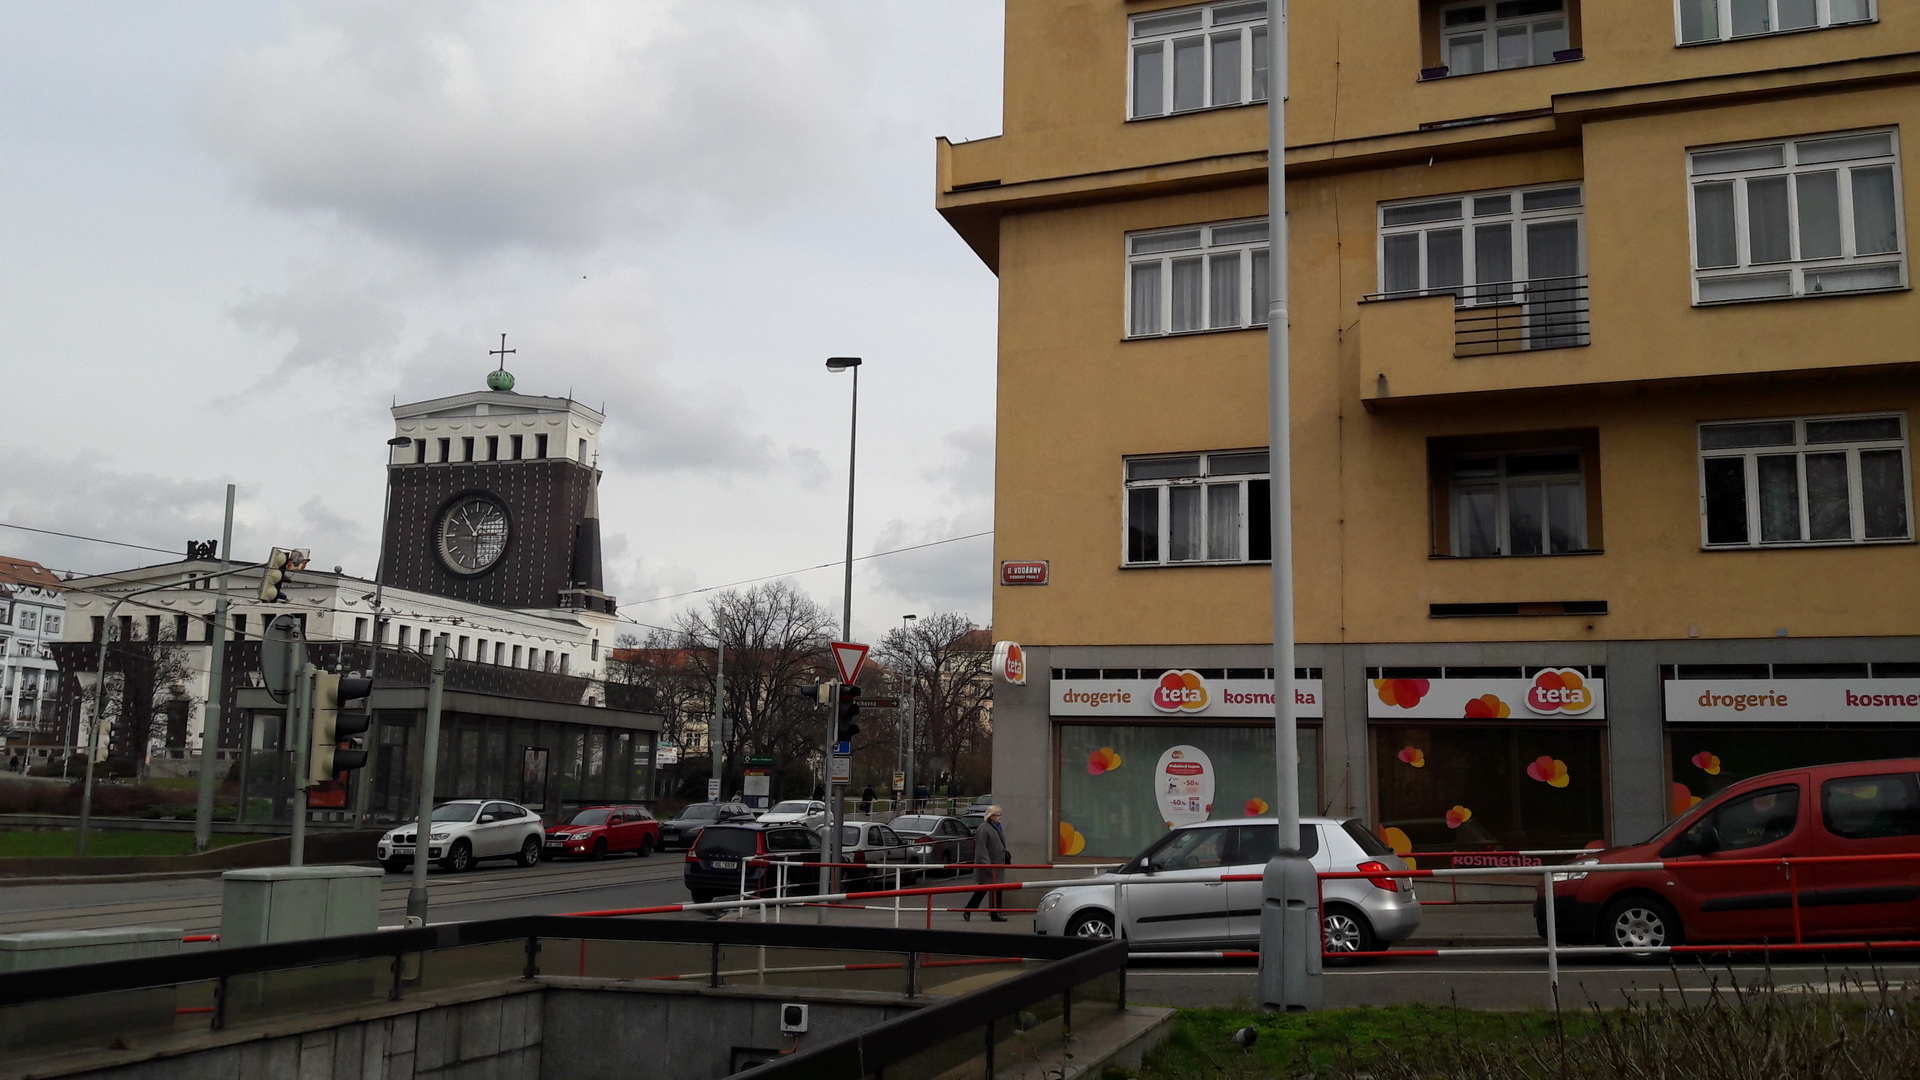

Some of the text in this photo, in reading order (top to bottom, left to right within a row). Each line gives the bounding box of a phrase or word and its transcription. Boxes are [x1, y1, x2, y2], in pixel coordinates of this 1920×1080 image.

[1014, 566, 1042, 574] VODÁRNY
[1007, 657, 1022, 675] teta
[1062, 689, 1132, 708] drogerie
[1160, 686, 1202, 703] teta
[1223, 689, 1316, 705] kosmeka
[1536, 684, 1584, 704] teta
[1698, 689, 1788, 711] drogerie
[1845, 689, 1920, 707] kosme
[1452, 855, 1543, 867] kosmetika
